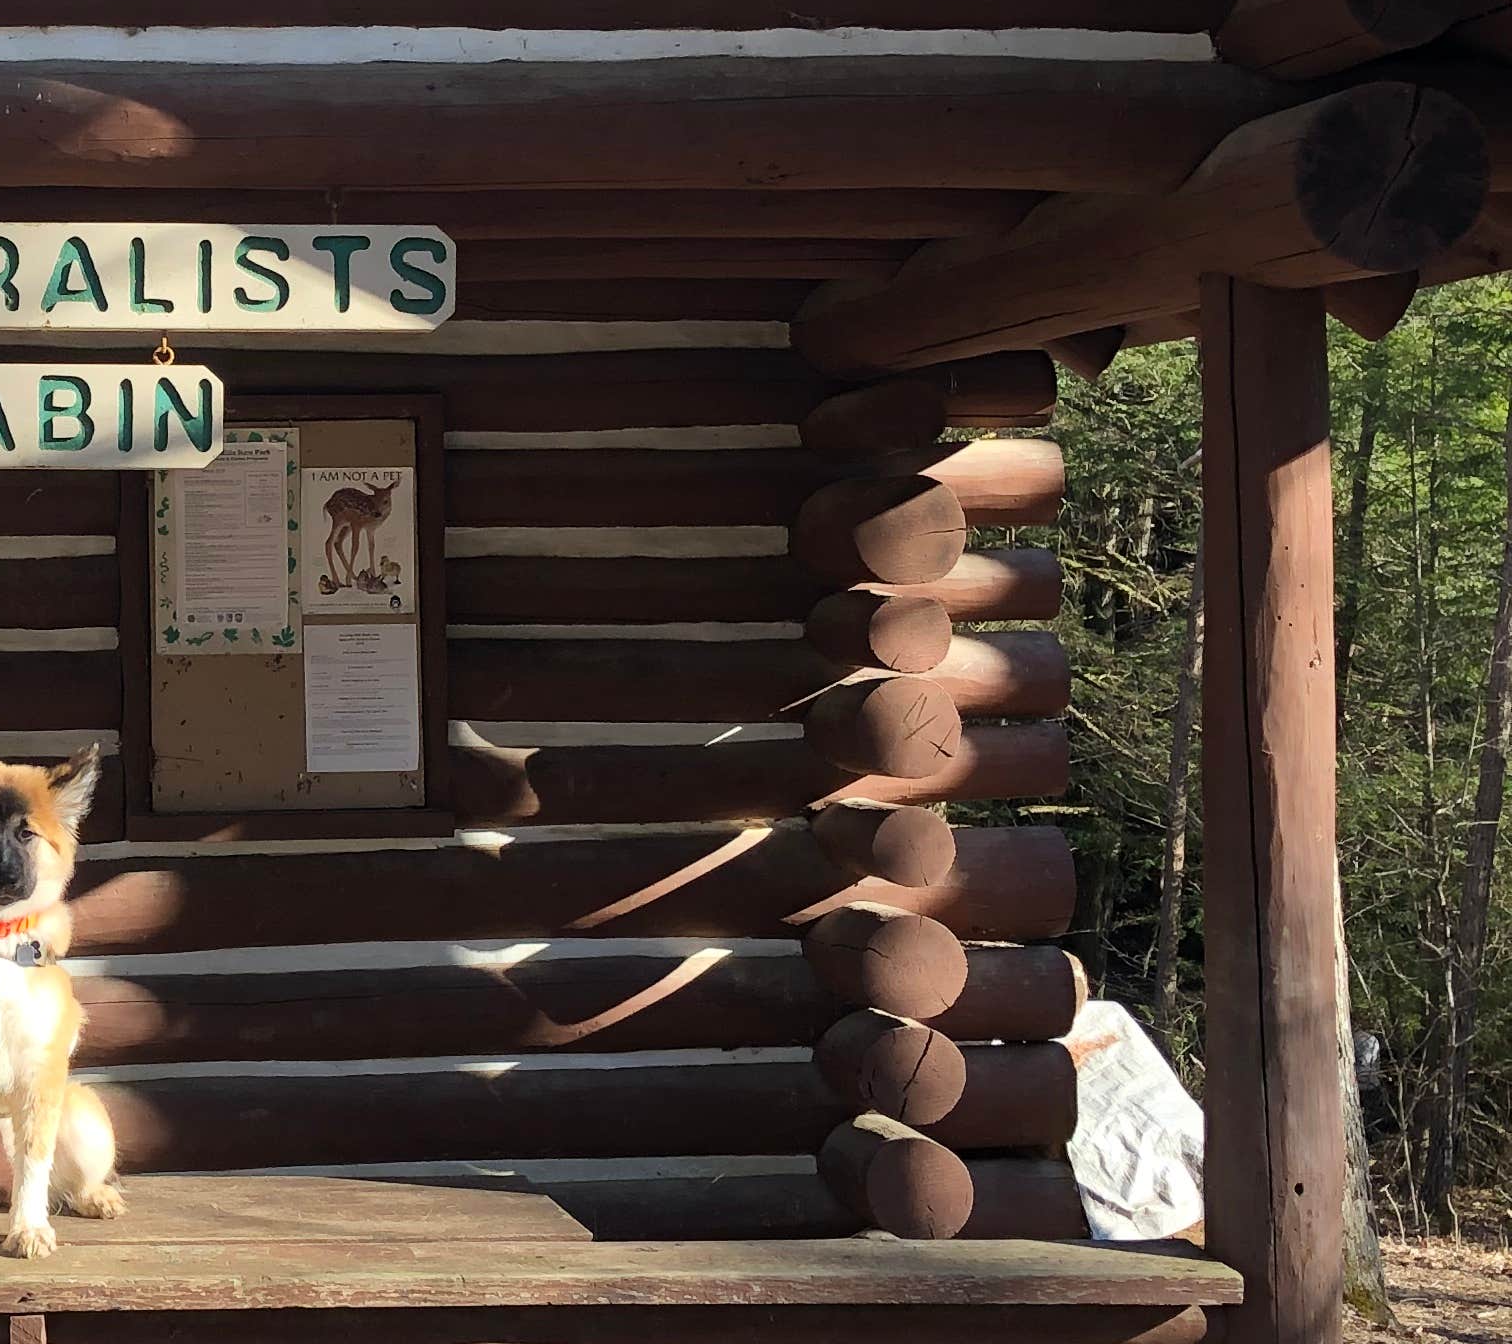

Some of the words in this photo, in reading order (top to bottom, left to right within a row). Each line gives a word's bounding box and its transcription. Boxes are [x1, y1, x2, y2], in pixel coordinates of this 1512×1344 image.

[319, 471, 339, 481] AM
[343, 471, 368, 481] NOT
[371, 471, 379, 481] A
[383, 471, 403, 481] PET
